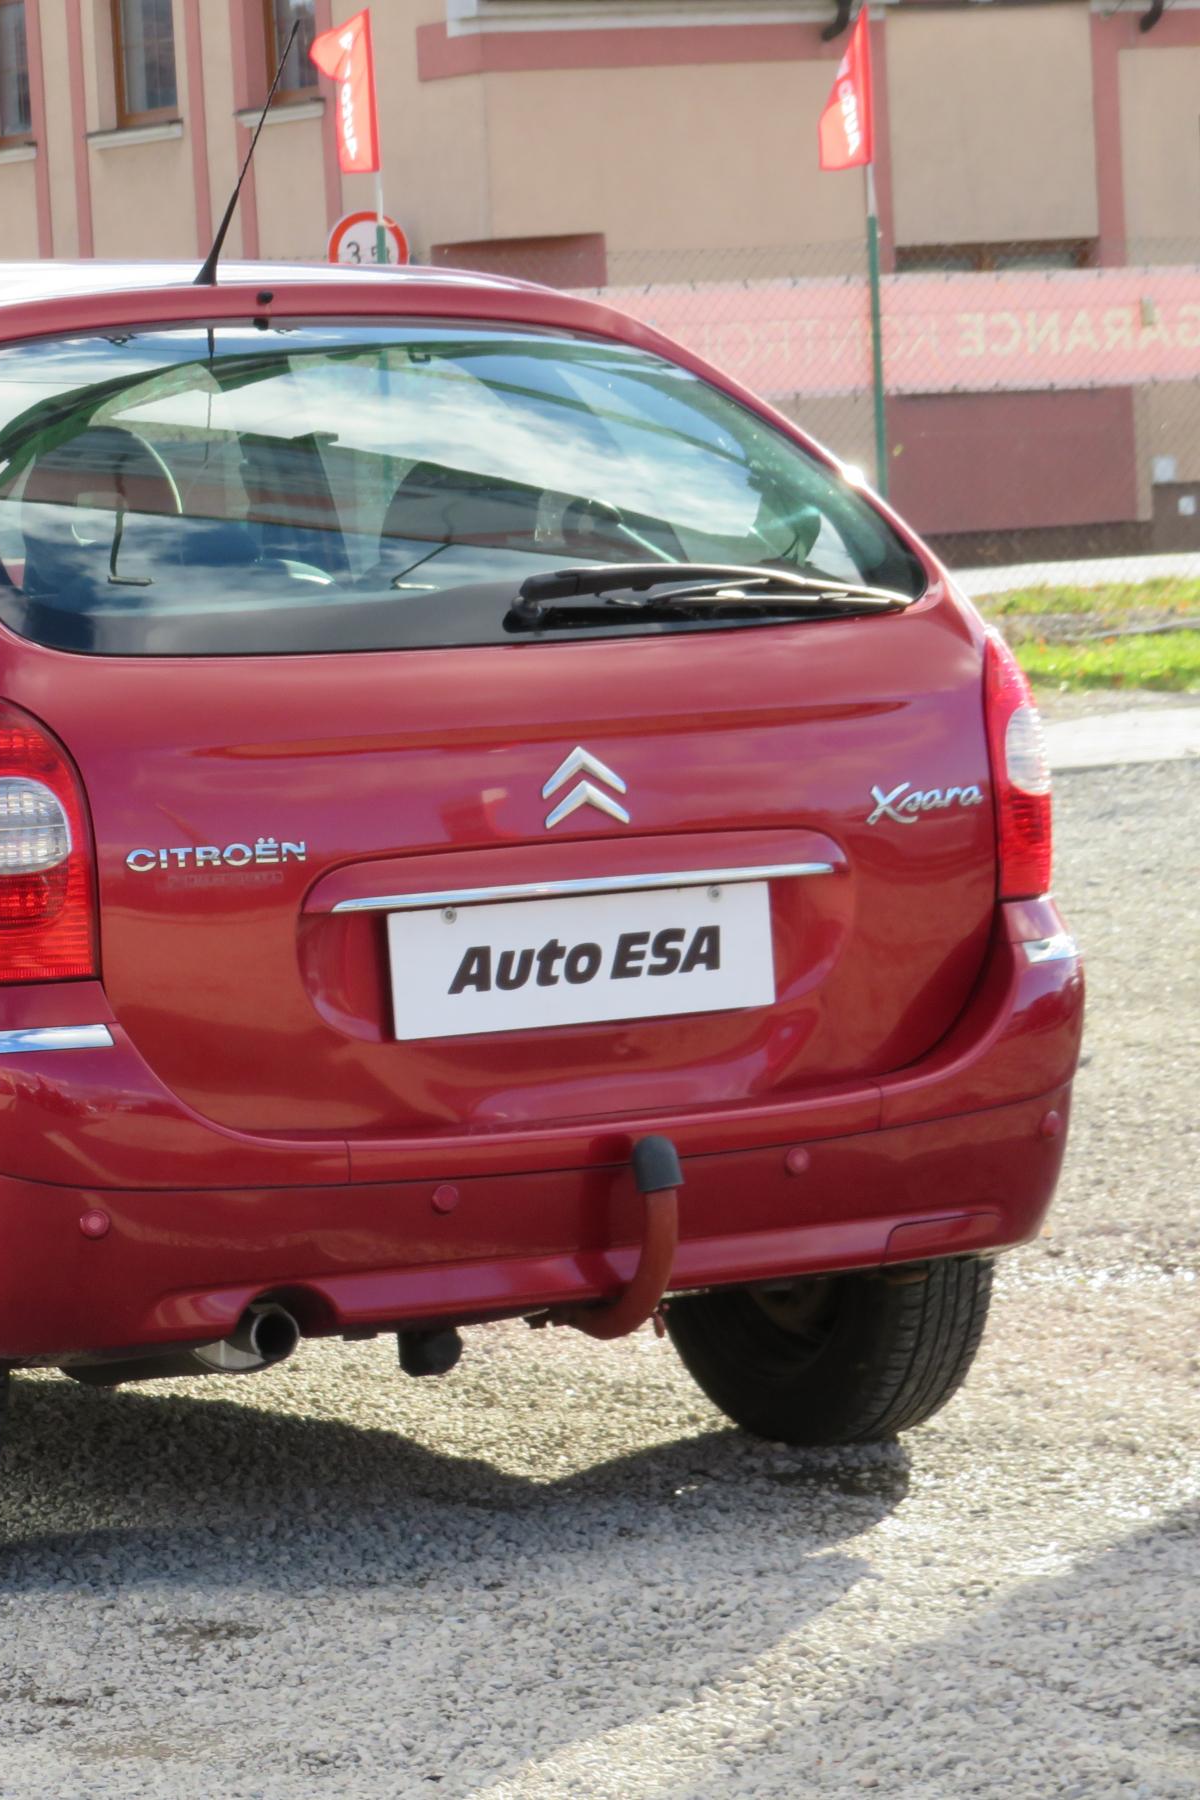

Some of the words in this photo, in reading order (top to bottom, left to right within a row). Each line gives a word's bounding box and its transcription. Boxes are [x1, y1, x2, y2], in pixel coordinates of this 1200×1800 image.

[866, 782, 984, 825] Xsara
[126, 837, 307, 872] CITROËN
[447, 938, 603, 995] Auto
[609, 925, 721, 980] ESA
